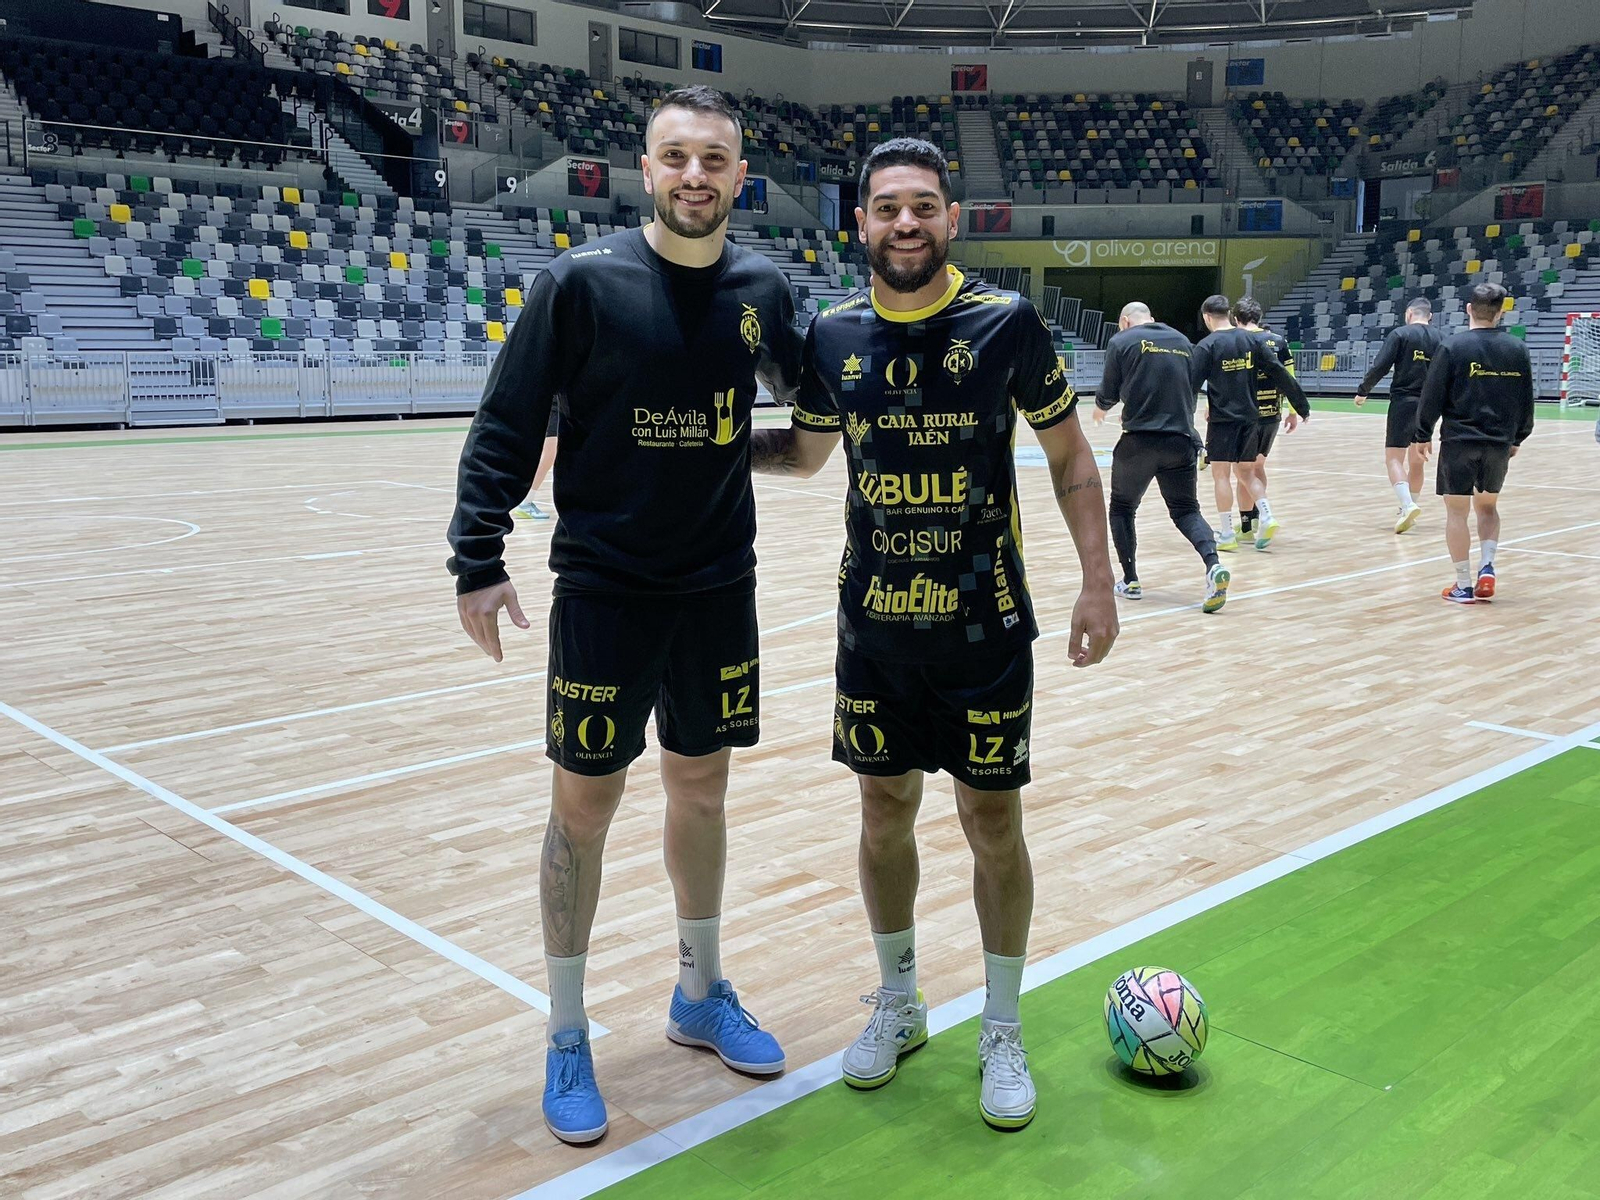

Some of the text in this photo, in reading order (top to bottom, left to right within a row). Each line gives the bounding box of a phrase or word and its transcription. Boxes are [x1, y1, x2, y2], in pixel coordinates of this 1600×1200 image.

[43, 132, 59, 154] 8
[567, 159, 595, 171] Sector
[847, 161, 857, 177] 5
[1380, 151, 1437, 172] Salida 6
[434, 170, 447, 188] 9
[506, 177, 518, 193] 9
[577, 161, 602, 197] 9
[1096, 240, 1145, 257] olivo
[1152, 241, 1215, 256] arena
[633, 406, 707, 425] DeÁvila
[1031, 411, 1045, 421] JPI
[1048, 402, 1062, 416] JPI
[877, 412, 979, 429] CAJA RURAL
[631, 425, 709, 438] con Luis Millán
[907, 428, 950, 446] JAÉN
[886, 508, 903, 516] BAR
[904, 506, 943, 515] GENUINO
[951, 504, 966, 514] CAF
[872, 529, 962, 556] COCISUR
[912, 613, 956, 622] AVANZADA
[722, 684, 753, 719] LZ
[575, 751, 613, 760] OLIVENCIA
[968, 733, 1004, 764] LZ
